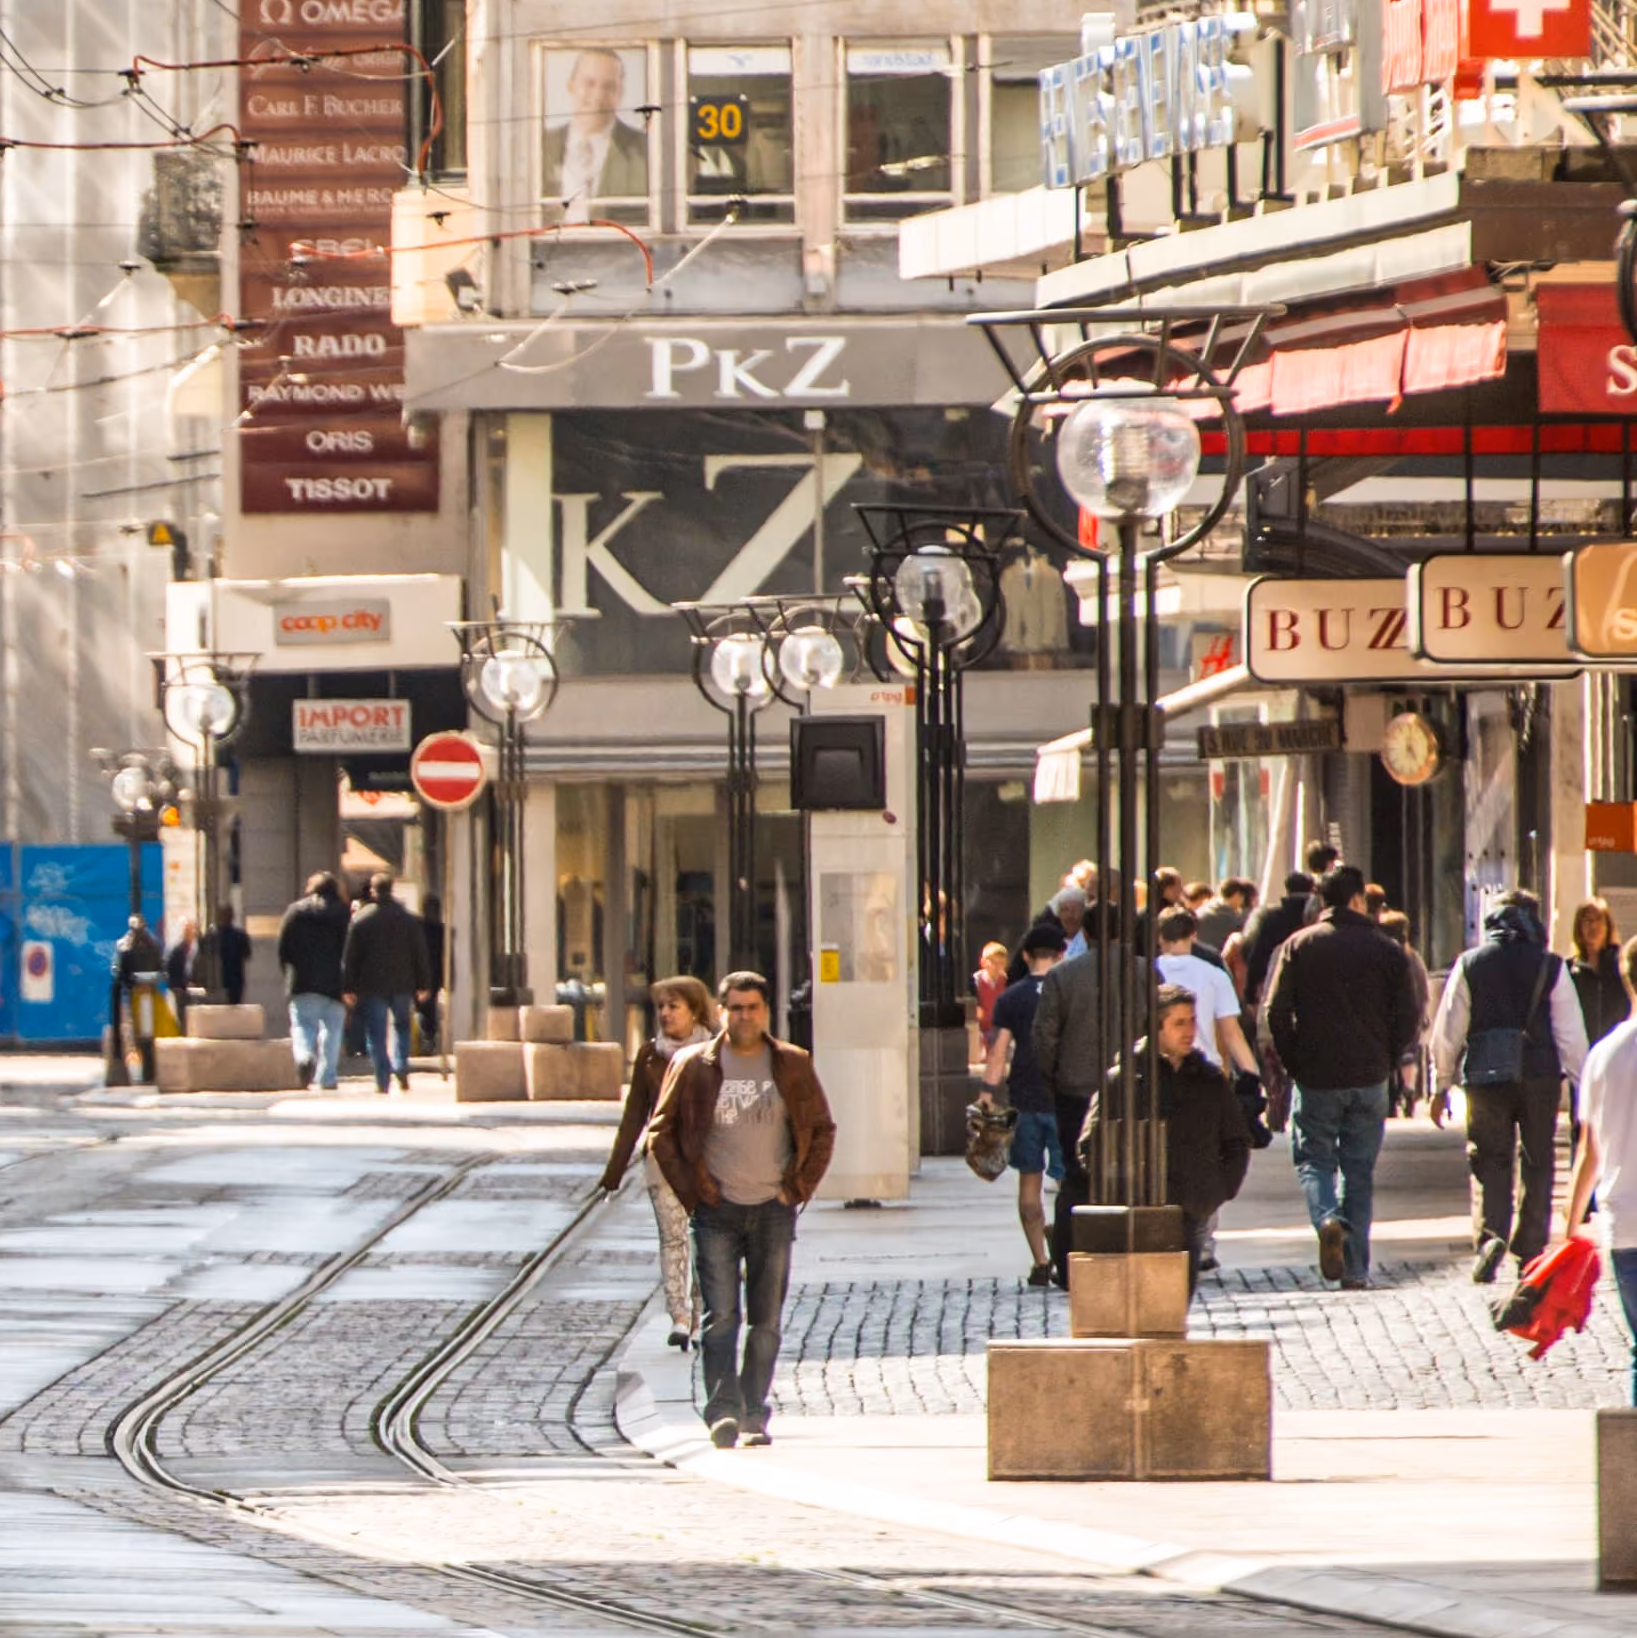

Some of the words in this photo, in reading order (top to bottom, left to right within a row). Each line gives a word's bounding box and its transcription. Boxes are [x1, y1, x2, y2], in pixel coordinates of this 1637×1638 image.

[696, 102, 743, 141] 30
[246, 144, 339, 164] MAURICE
[246, 190, 316, 206] BAUME
[293, 333, 387, 357] RADO
[247, 384, 365, 402] RAYMOND
[306, 430, 374, 453] ORIS
[285, 477, 393, 502] TISSOT
[280, 613, 338, 635] coop
[340, 609, 384, 633] city
[298, 704, 406, 728] IMPORT
